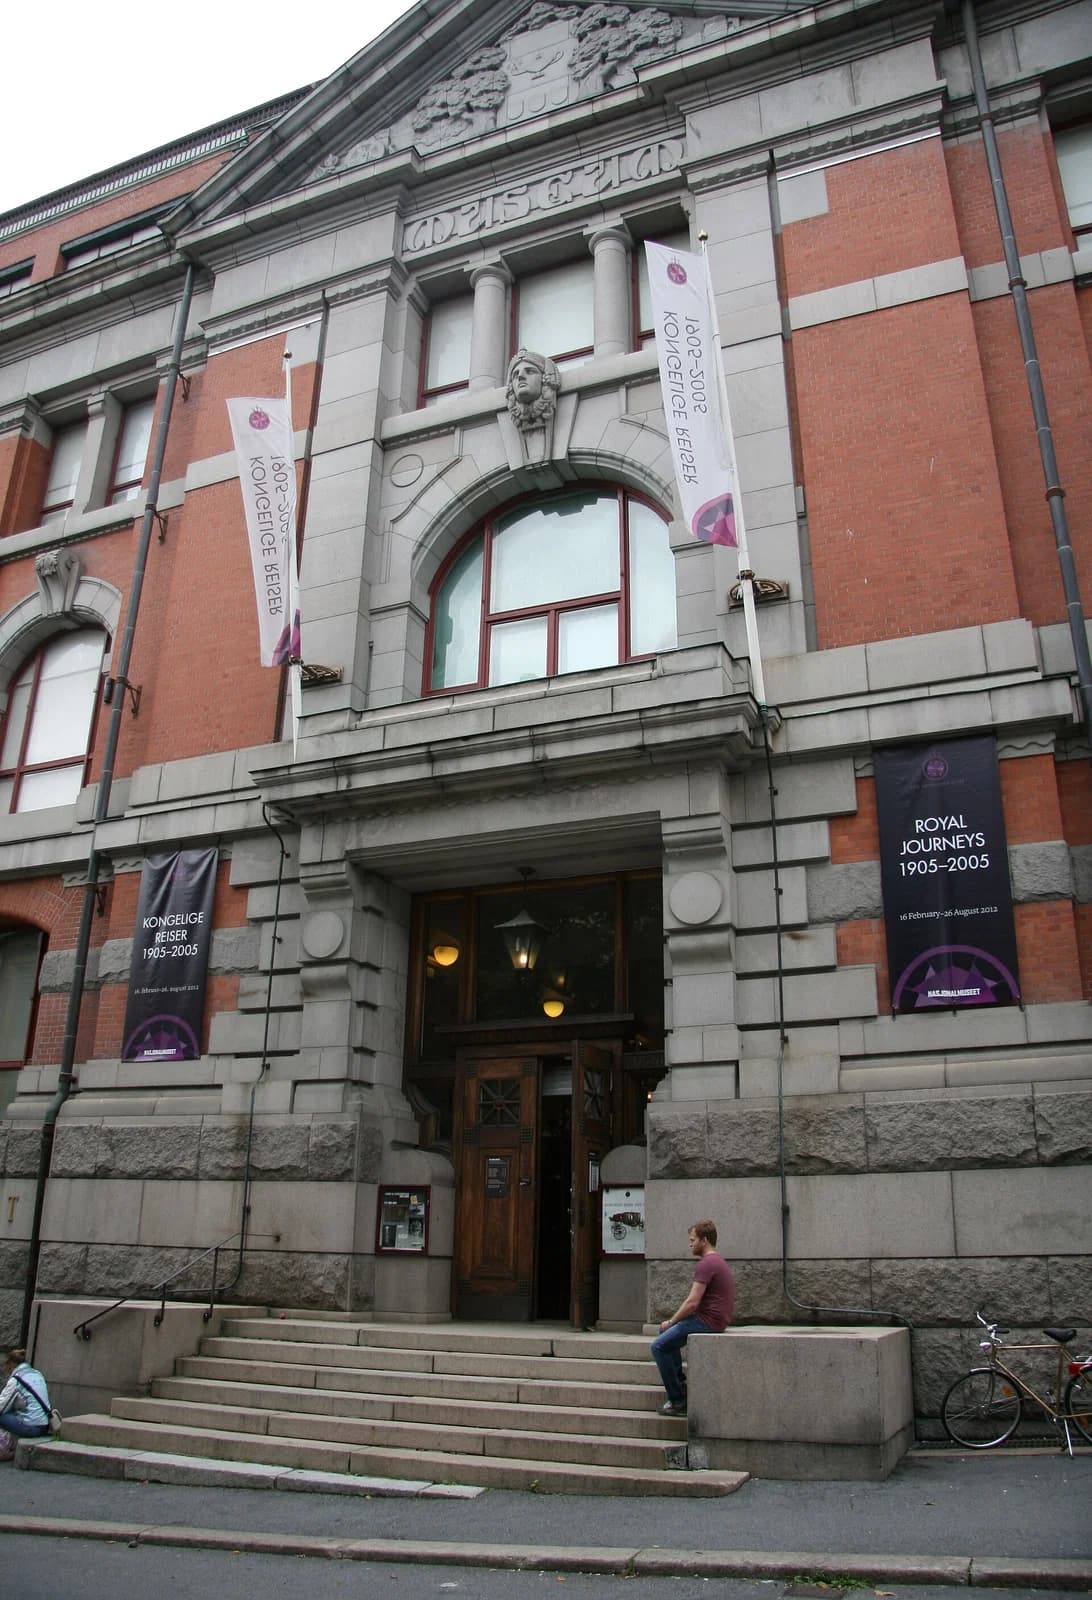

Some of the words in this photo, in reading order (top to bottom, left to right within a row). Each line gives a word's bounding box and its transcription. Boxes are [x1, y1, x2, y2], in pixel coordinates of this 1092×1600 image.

[915, 814, 968, 834] ROYAL
[900, 832, 985, 855] JOURNEYS
[143, 911, 205, 929] KONGELIGE
[954, 907, 980, 917] August
[980, 906, 999, 914] 2012
[155, 929, 188, 944] REISER
